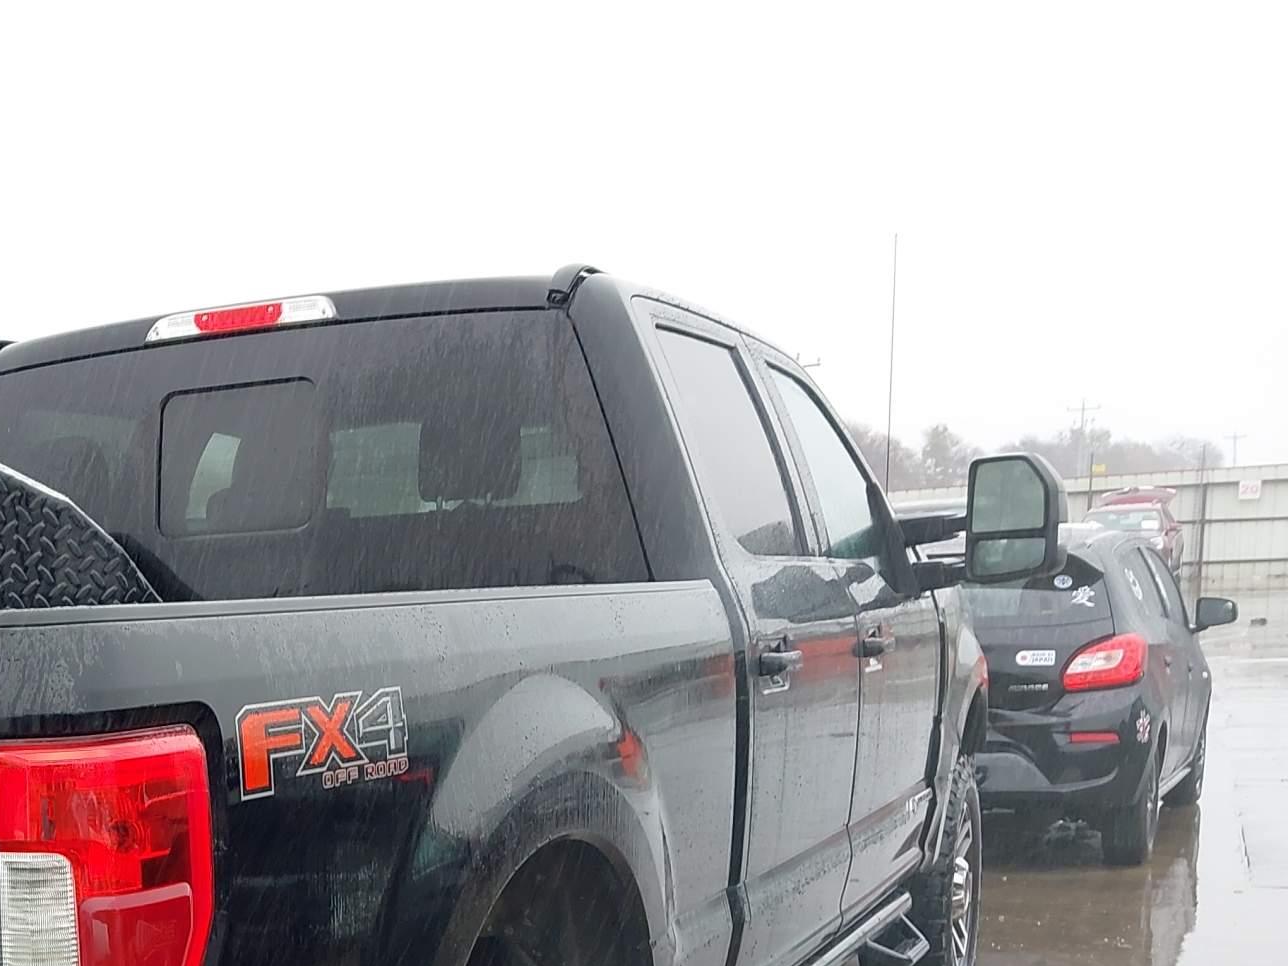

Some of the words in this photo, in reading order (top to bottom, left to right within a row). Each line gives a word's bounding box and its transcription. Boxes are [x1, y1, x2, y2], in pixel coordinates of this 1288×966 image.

[235, 686, 408, 801] FX4
[322, 766, 360, 790] OFF
[364, 757, 409, 781] ROAD
